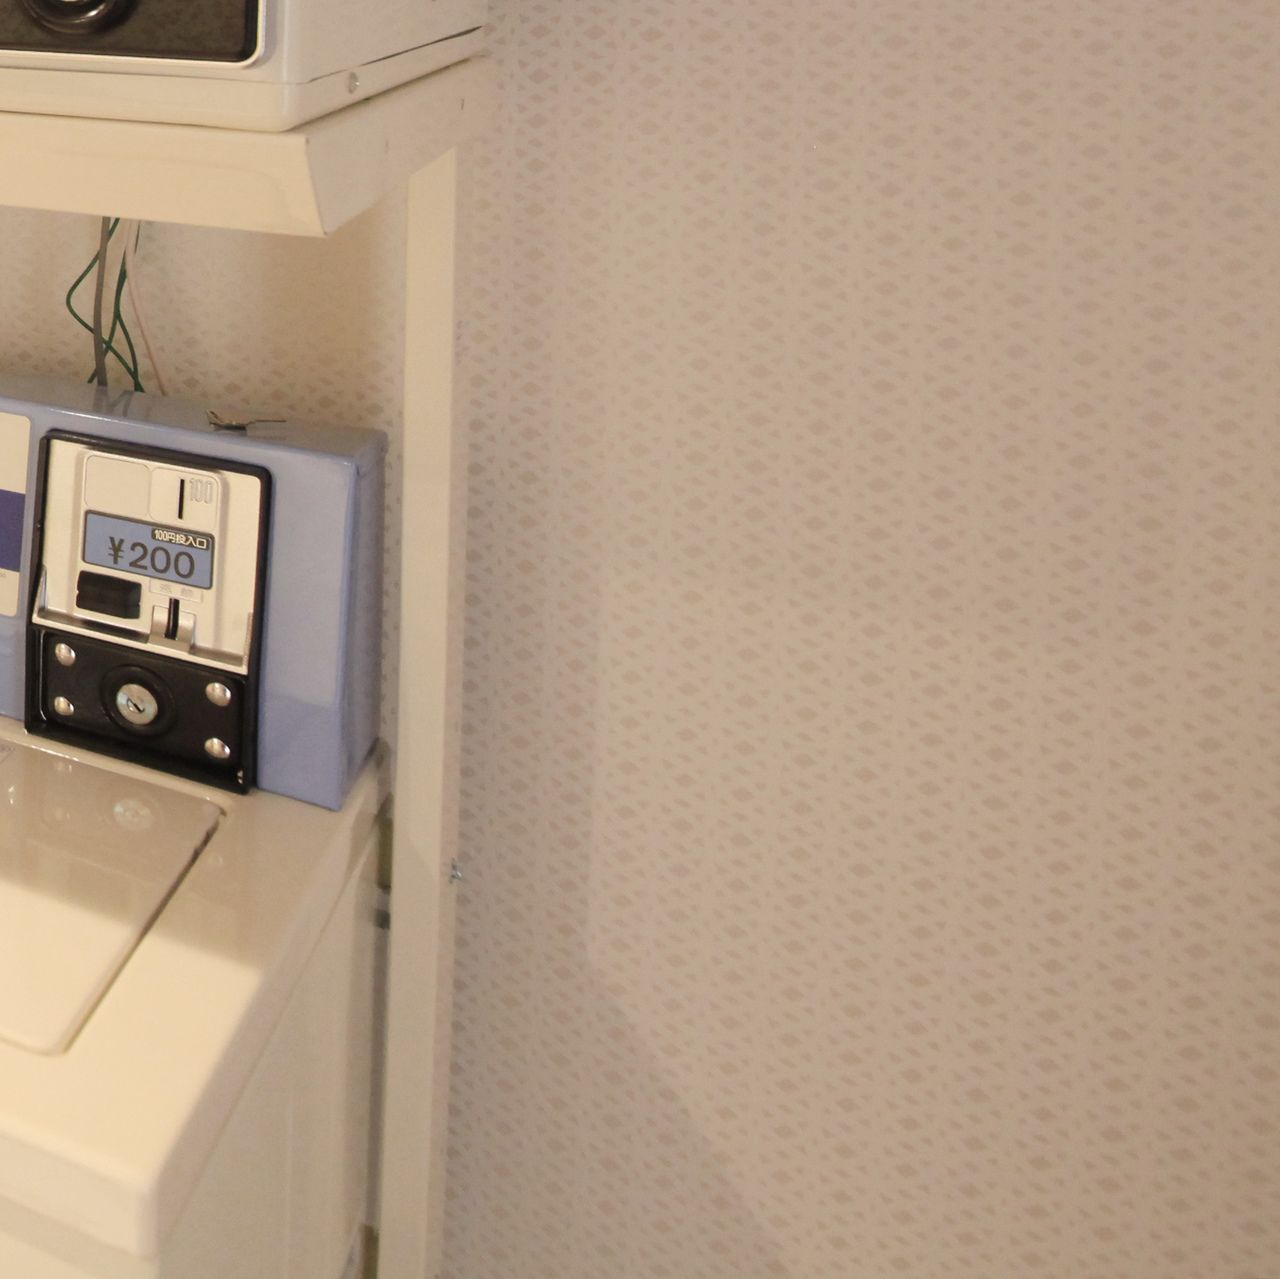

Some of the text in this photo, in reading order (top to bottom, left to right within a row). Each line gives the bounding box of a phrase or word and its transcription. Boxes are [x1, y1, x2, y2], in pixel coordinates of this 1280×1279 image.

[154, 529, 207, 549] 100円投入口
[108, 536, 195, 579] ¥200
